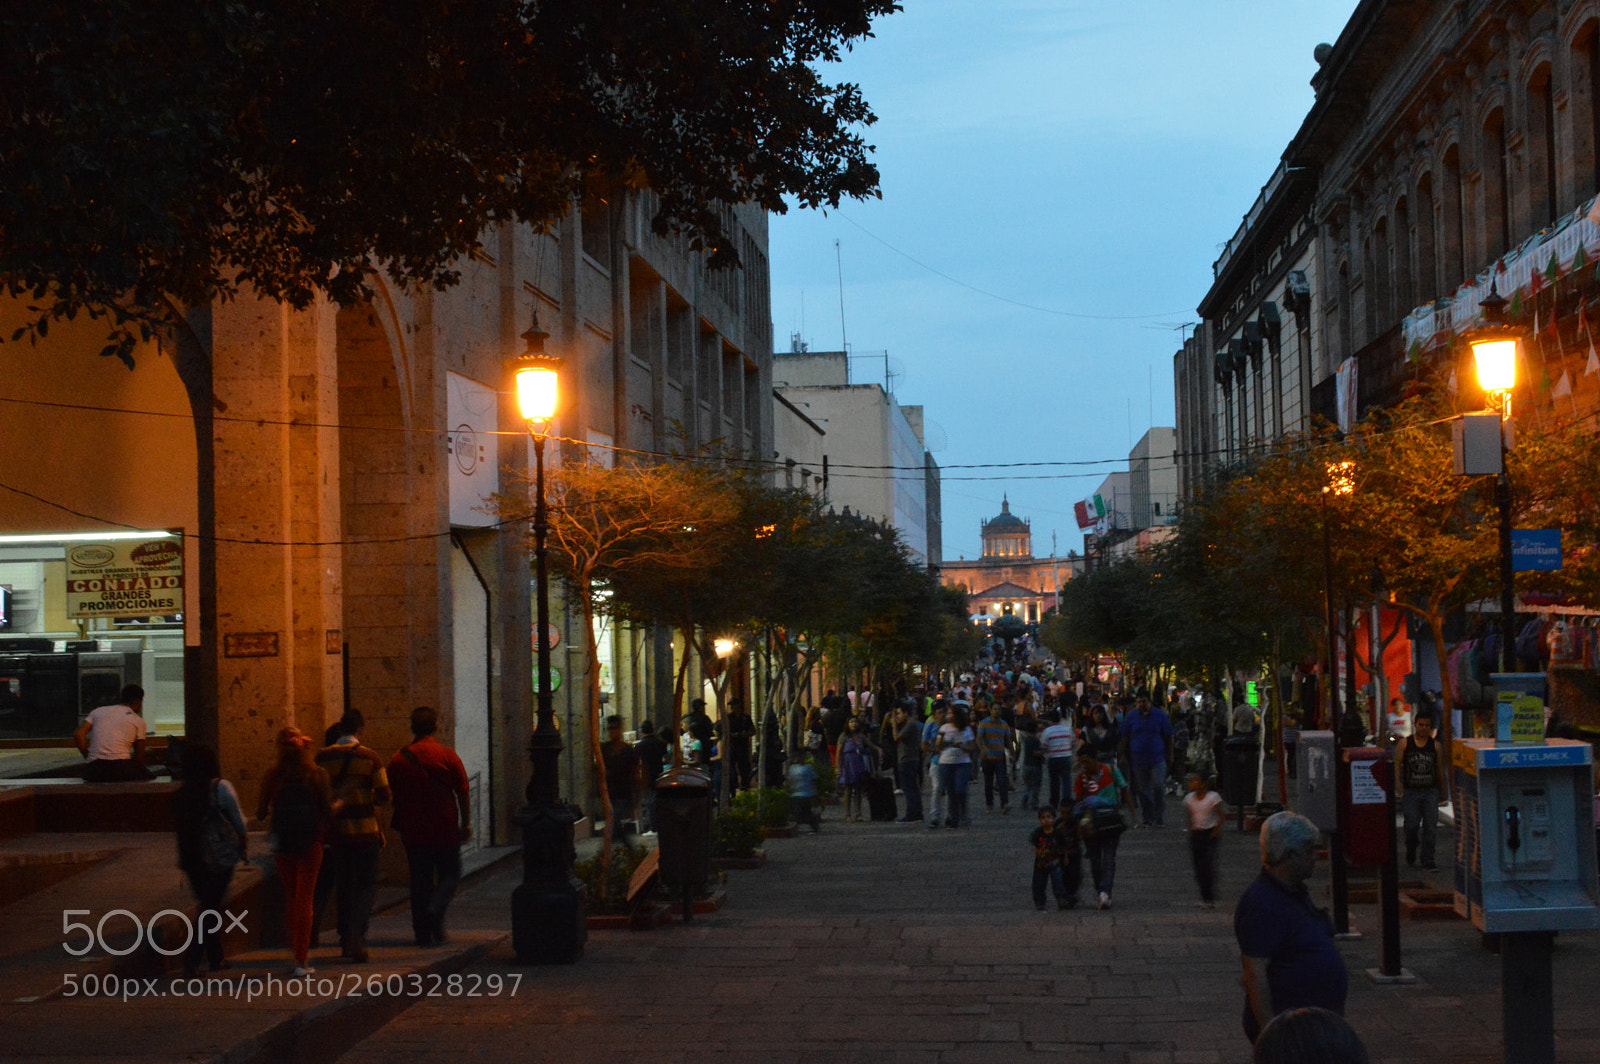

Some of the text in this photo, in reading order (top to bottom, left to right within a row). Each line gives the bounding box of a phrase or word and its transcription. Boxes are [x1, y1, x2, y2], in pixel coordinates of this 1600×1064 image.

[134, 551, 179, 563] APROVECHA
[73, 576, 179, 592] CONTADO
[101, 590, 151, 601] GRANDES
[80, 598, 174, 611] PROMOCIONES
[1521, 752, 1569, 761] TELMEX
